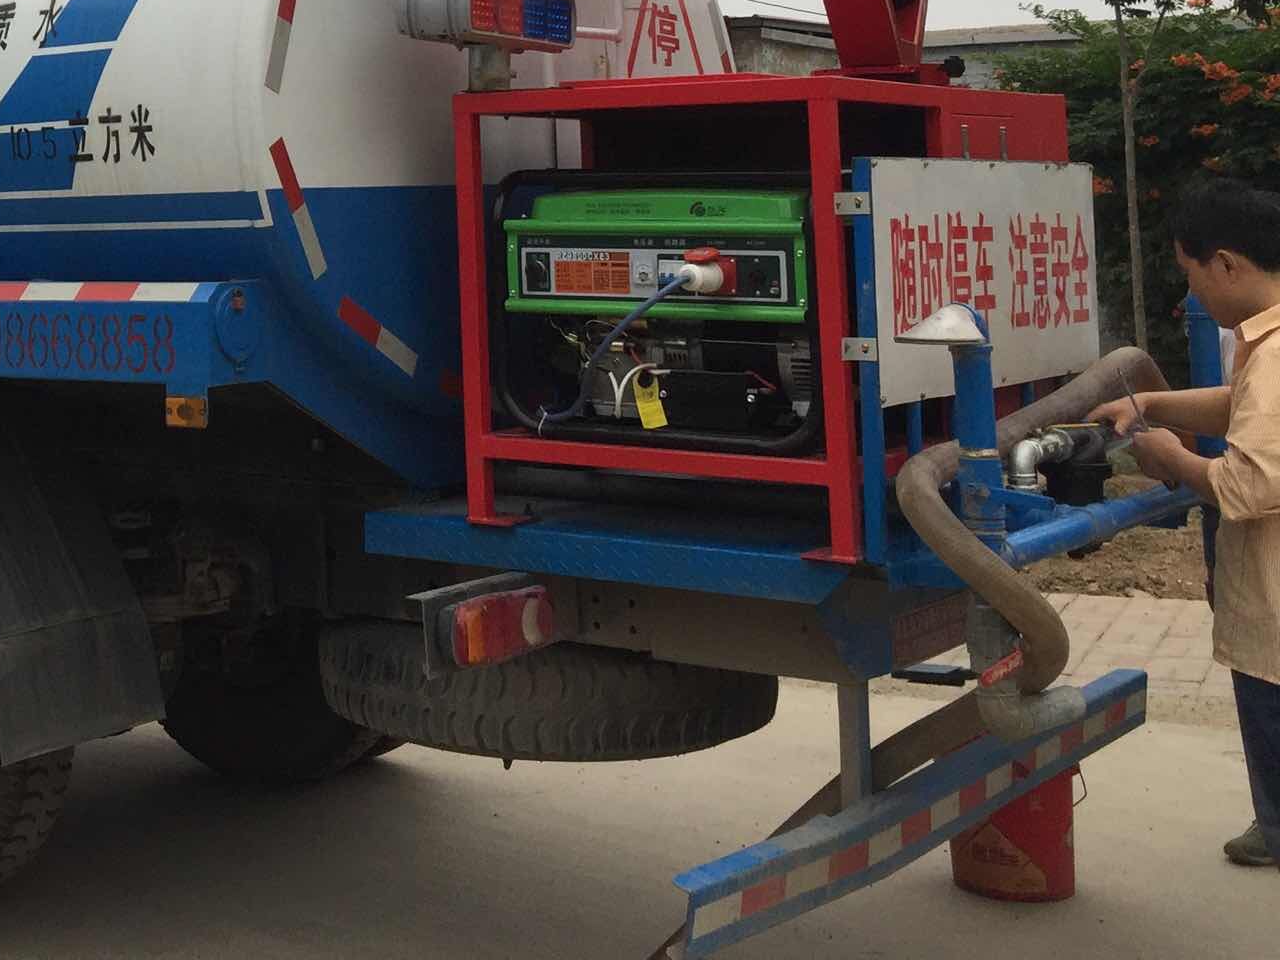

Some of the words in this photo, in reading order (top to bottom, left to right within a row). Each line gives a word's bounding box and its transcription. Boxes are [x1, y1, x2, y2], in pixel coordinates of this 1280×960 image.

[647, 2, 680, 68] 停
[889, 211, 997, 338] 随时停车
[1008, 212, 1089, 330] 注意安全
